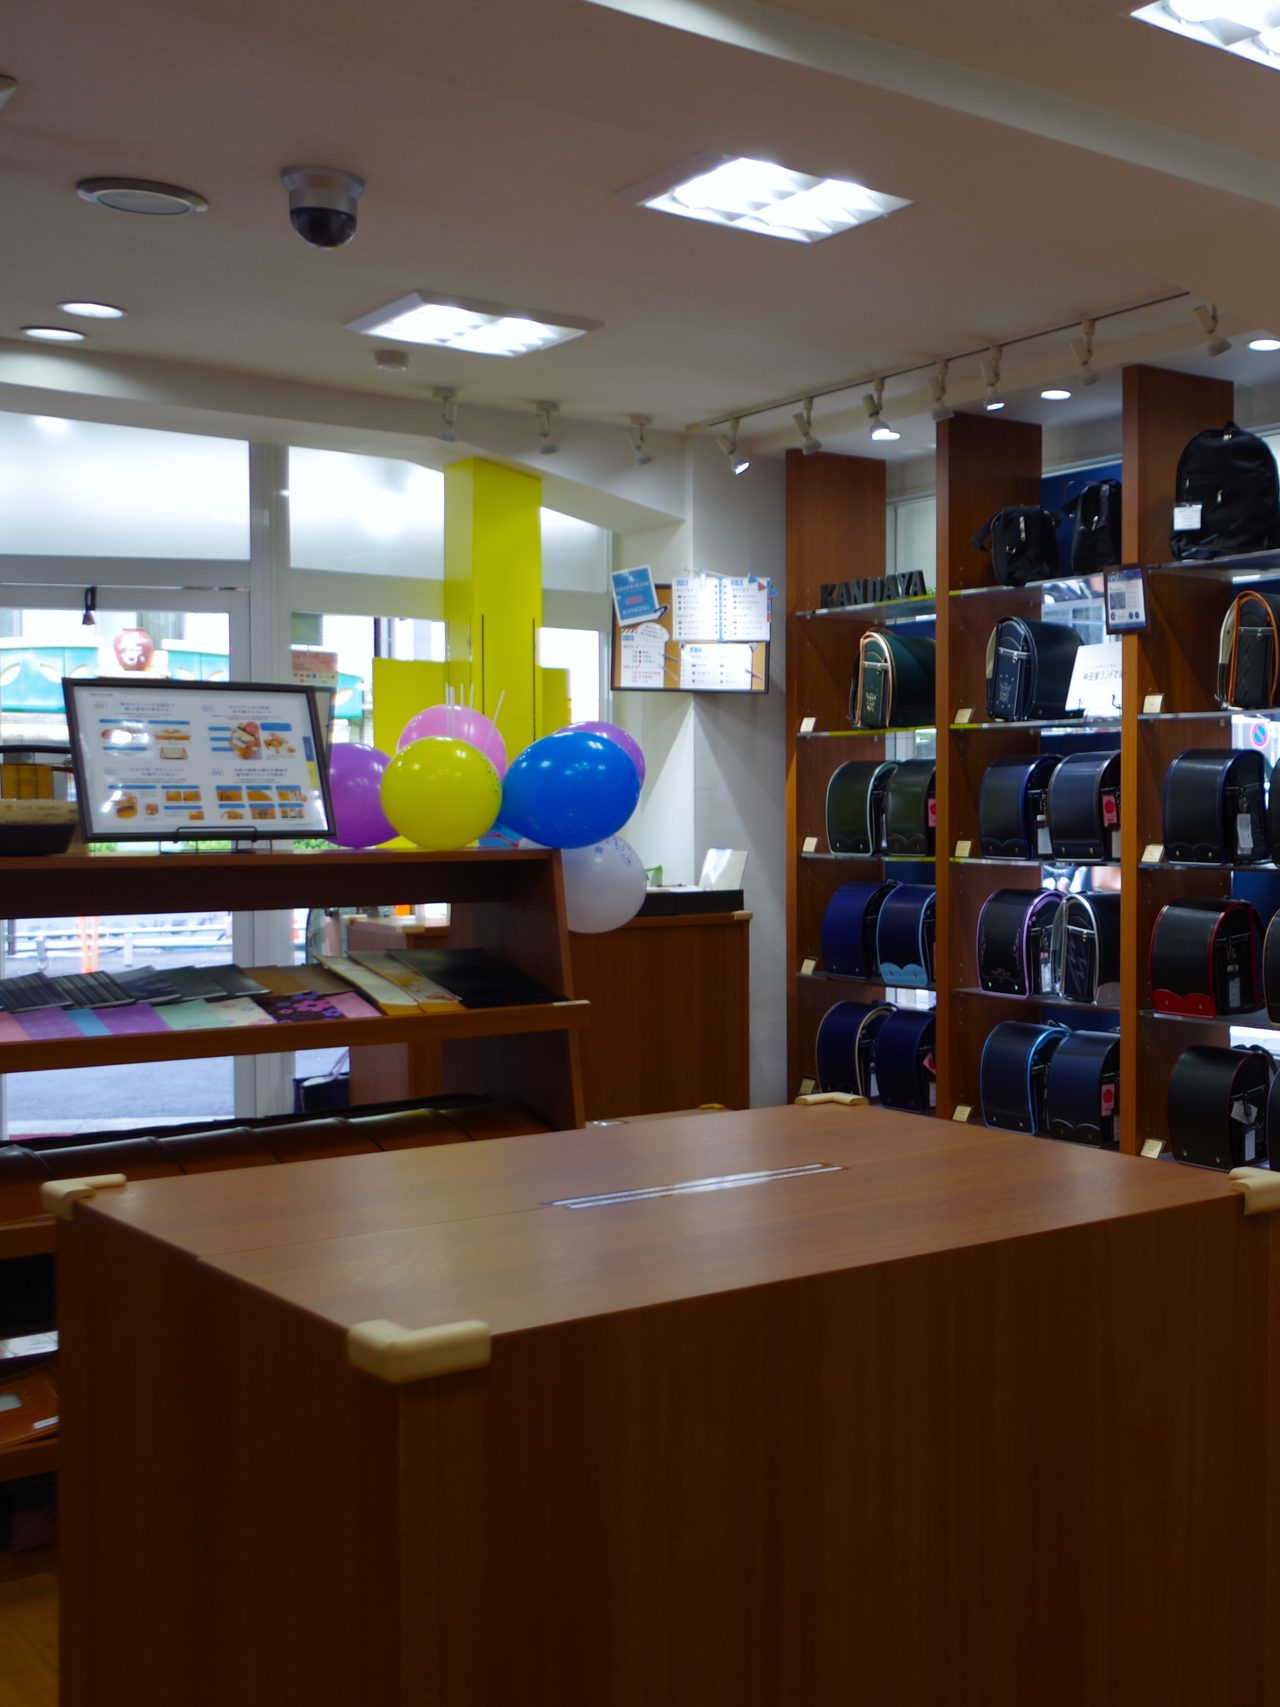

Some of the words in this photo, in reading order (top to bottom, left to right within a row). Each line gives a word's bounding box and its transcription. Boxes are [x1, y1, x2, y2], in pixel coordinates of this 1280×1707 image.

[820, 570, 927, 608] KANDAYA
[1082, 669, 1122, 681] 神田屋ランドセ
